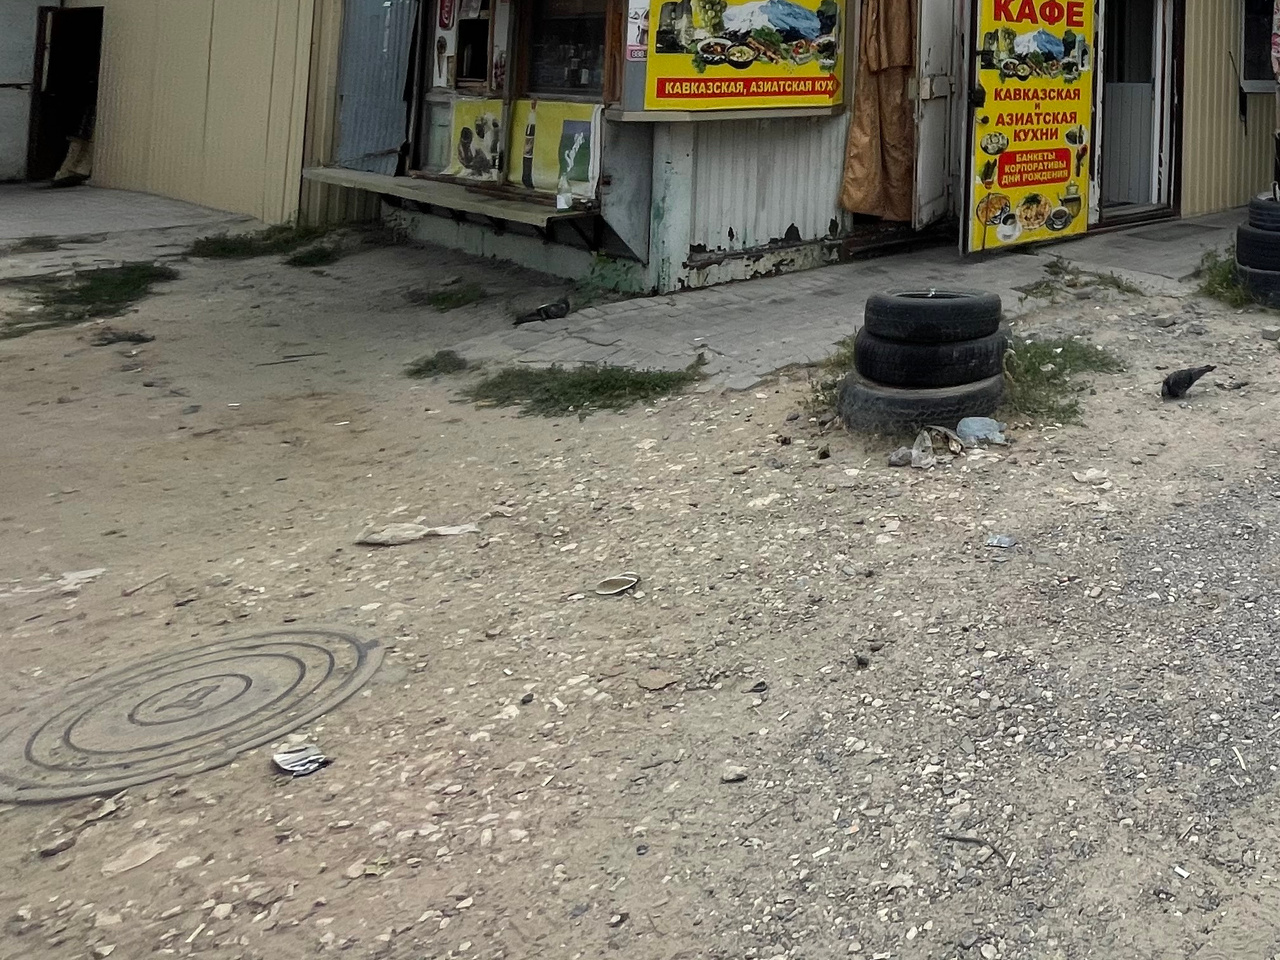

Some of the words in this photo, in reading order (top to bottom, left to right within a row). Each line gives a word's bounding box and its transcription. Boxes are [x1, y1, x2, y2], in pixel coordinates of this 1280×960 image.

[665, 81, 747, 95] КАВКАЗСКАЯ,
[750, 79, 811, 93] АЗИАТСКАЯ
[994, 87, 1081, 101] КАВКАЗСКАЯ
[995, 111, 1077, 126] АЗИАТСКАЯ
[1013, 127, 1059, 142] КУХНИ
[1015, 152, 1056, 162] БАНКЕТЫ
[1004, 160, 1067, 173] КОРПОРАТИВЫ
[1001, 173, 1021, 185] ДНИ
[1022, 169, 1068, 181] РОЖДЕНИЯ
